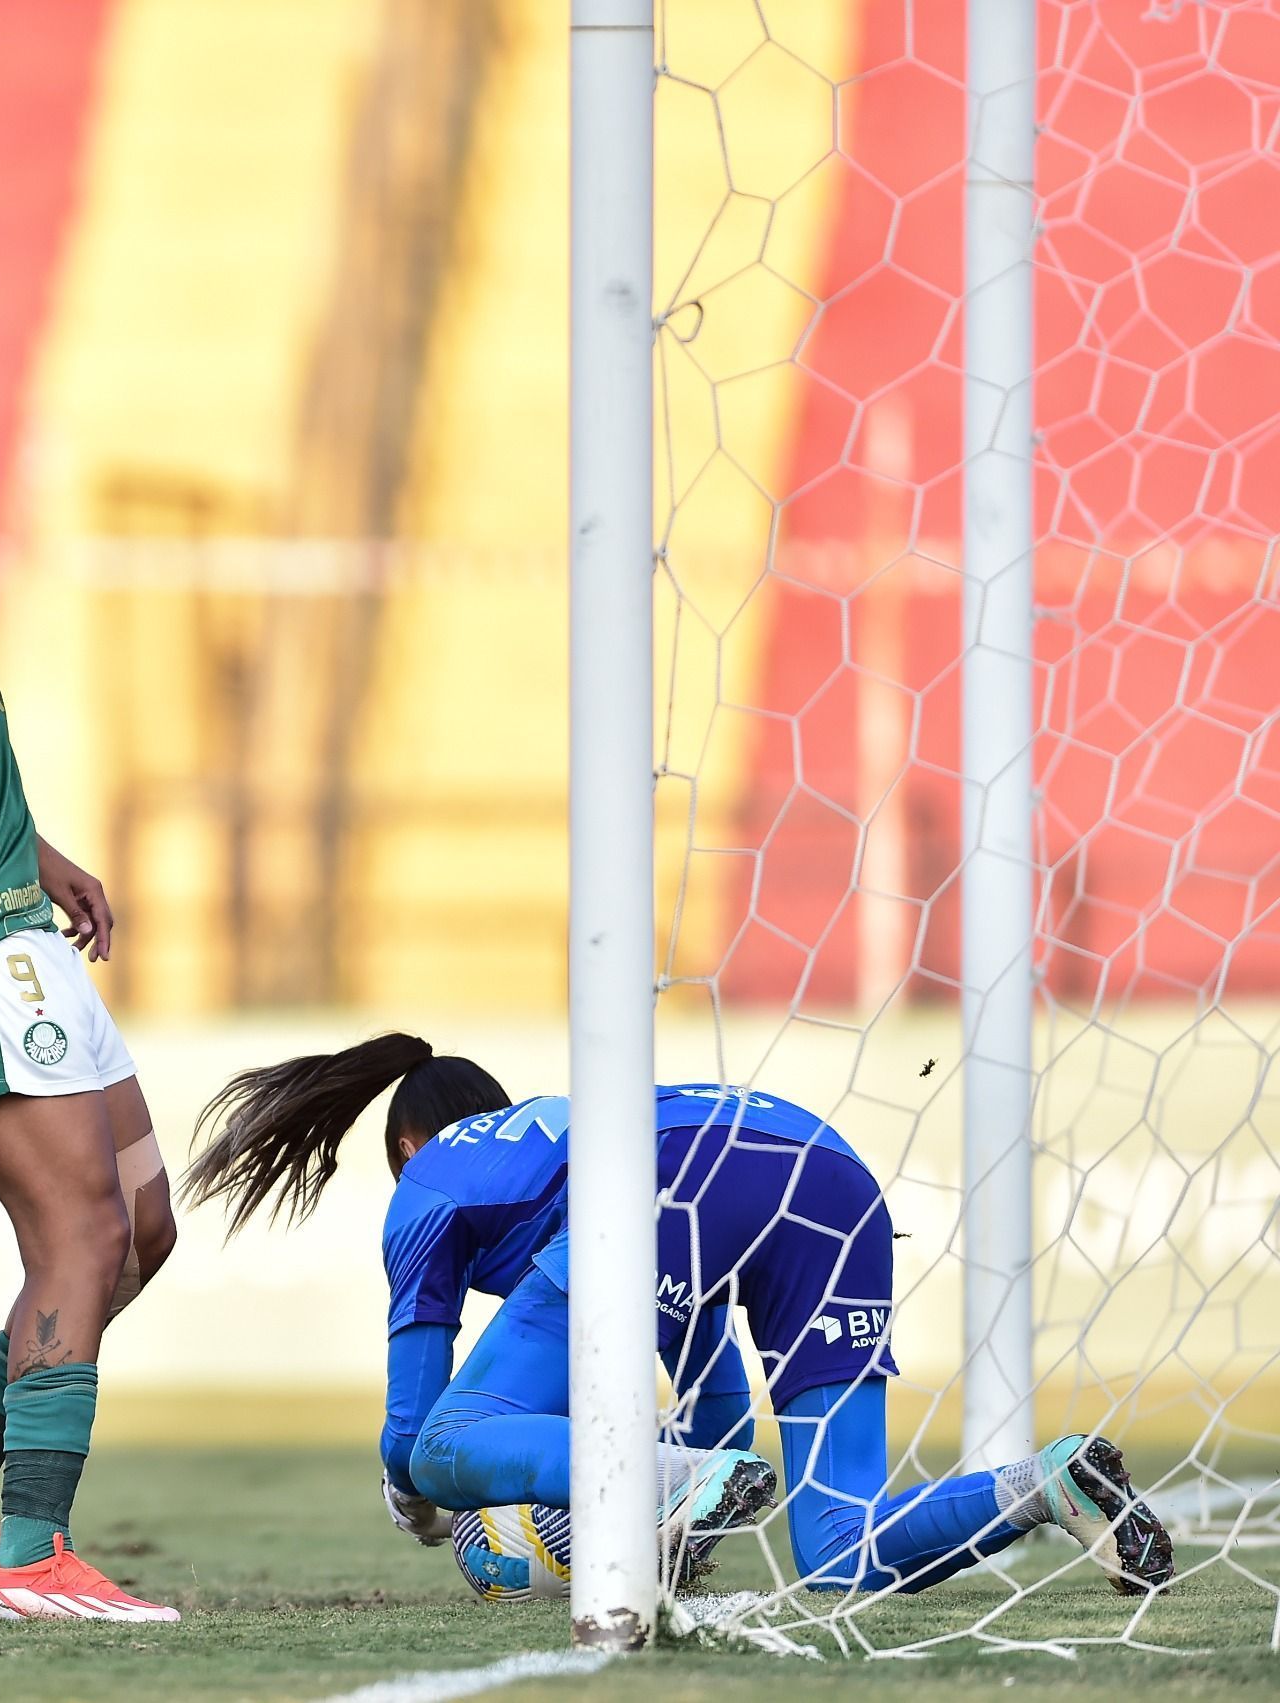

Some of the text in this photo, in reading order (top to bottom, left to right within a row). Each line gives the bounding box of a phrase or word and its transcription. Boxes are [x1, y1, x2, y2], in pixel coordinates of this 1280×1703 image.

[6, 953, 45, 1002] 9
[25, 1038, 66, 1064] PALMEIRAS
[655, 1270, 696, 1313] MA
[847, 1309, 885, 1337] BM
